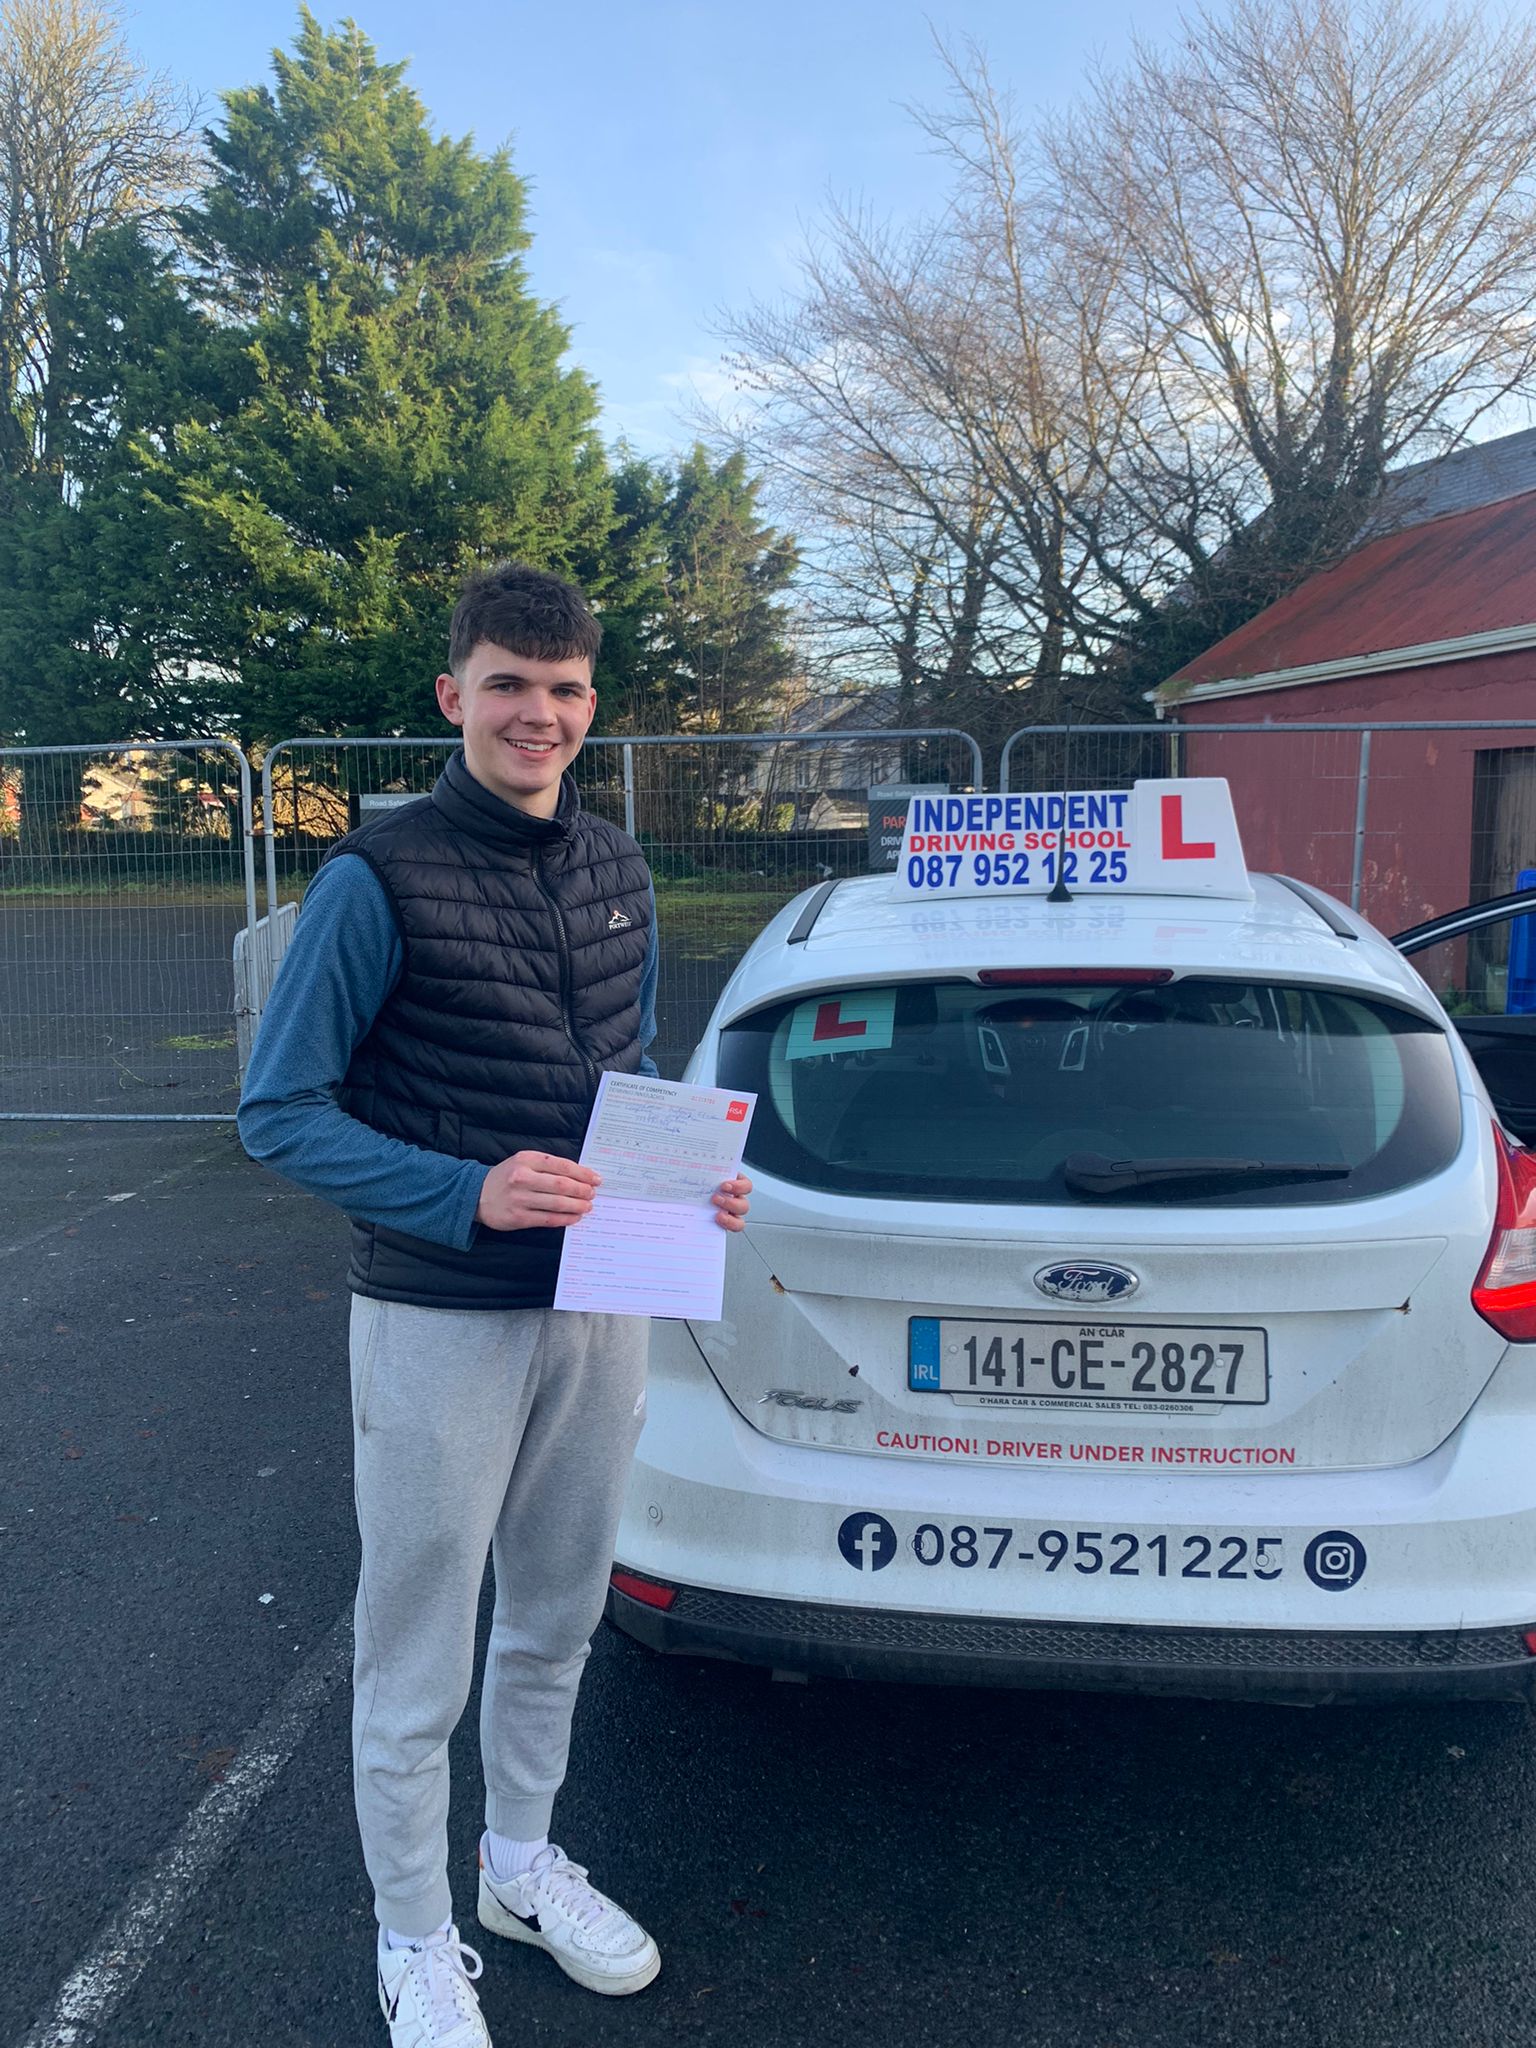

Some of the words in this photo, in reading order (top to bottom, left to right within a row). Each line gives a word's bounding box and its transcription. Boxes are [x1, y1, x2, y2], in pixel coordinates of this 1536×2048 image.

[882, 816, 906, 829] PAR
[914, 795, 1128, 832] INDEPENDENT
[1161, 795, 1216, 860] L
[881, 836, 904, 847] DRIV
[909, 833, 1015, 853] DRIVING
[1024, 831, 1131, 850] SCHOOL
[908, 855, 963, 888] 087
[974, 853, 1029, 886] 952
[1042, 852, 1078, 885] 12
[1090, 851, 1127, 883] 25
[813, 1001, 867, 1041] L
[1058, 1269, 1114, 1293] Ford
[1079, 1328, 1095, 1337] AN
[914, 1364, 938, 1380] IRL
[963, 1336, 1244, 1395] 141-CE-2827
[979, 1397, 1009, 1405] O'HARA
[1039, 1400, 1093, 1408] COMMERCIAL
[1095, 1402, 1121, 1410] SALES
[877, 1431, 978, 1454] CAUTION!
[987, 1440, 1062, 1459] DRIVER
[1070, 1444, 1144, 1462] UNDER
[1151, 1447, 1296, 1464] INSTRUCTION
[914, 1523, 1283, 1580] 087-9521225
